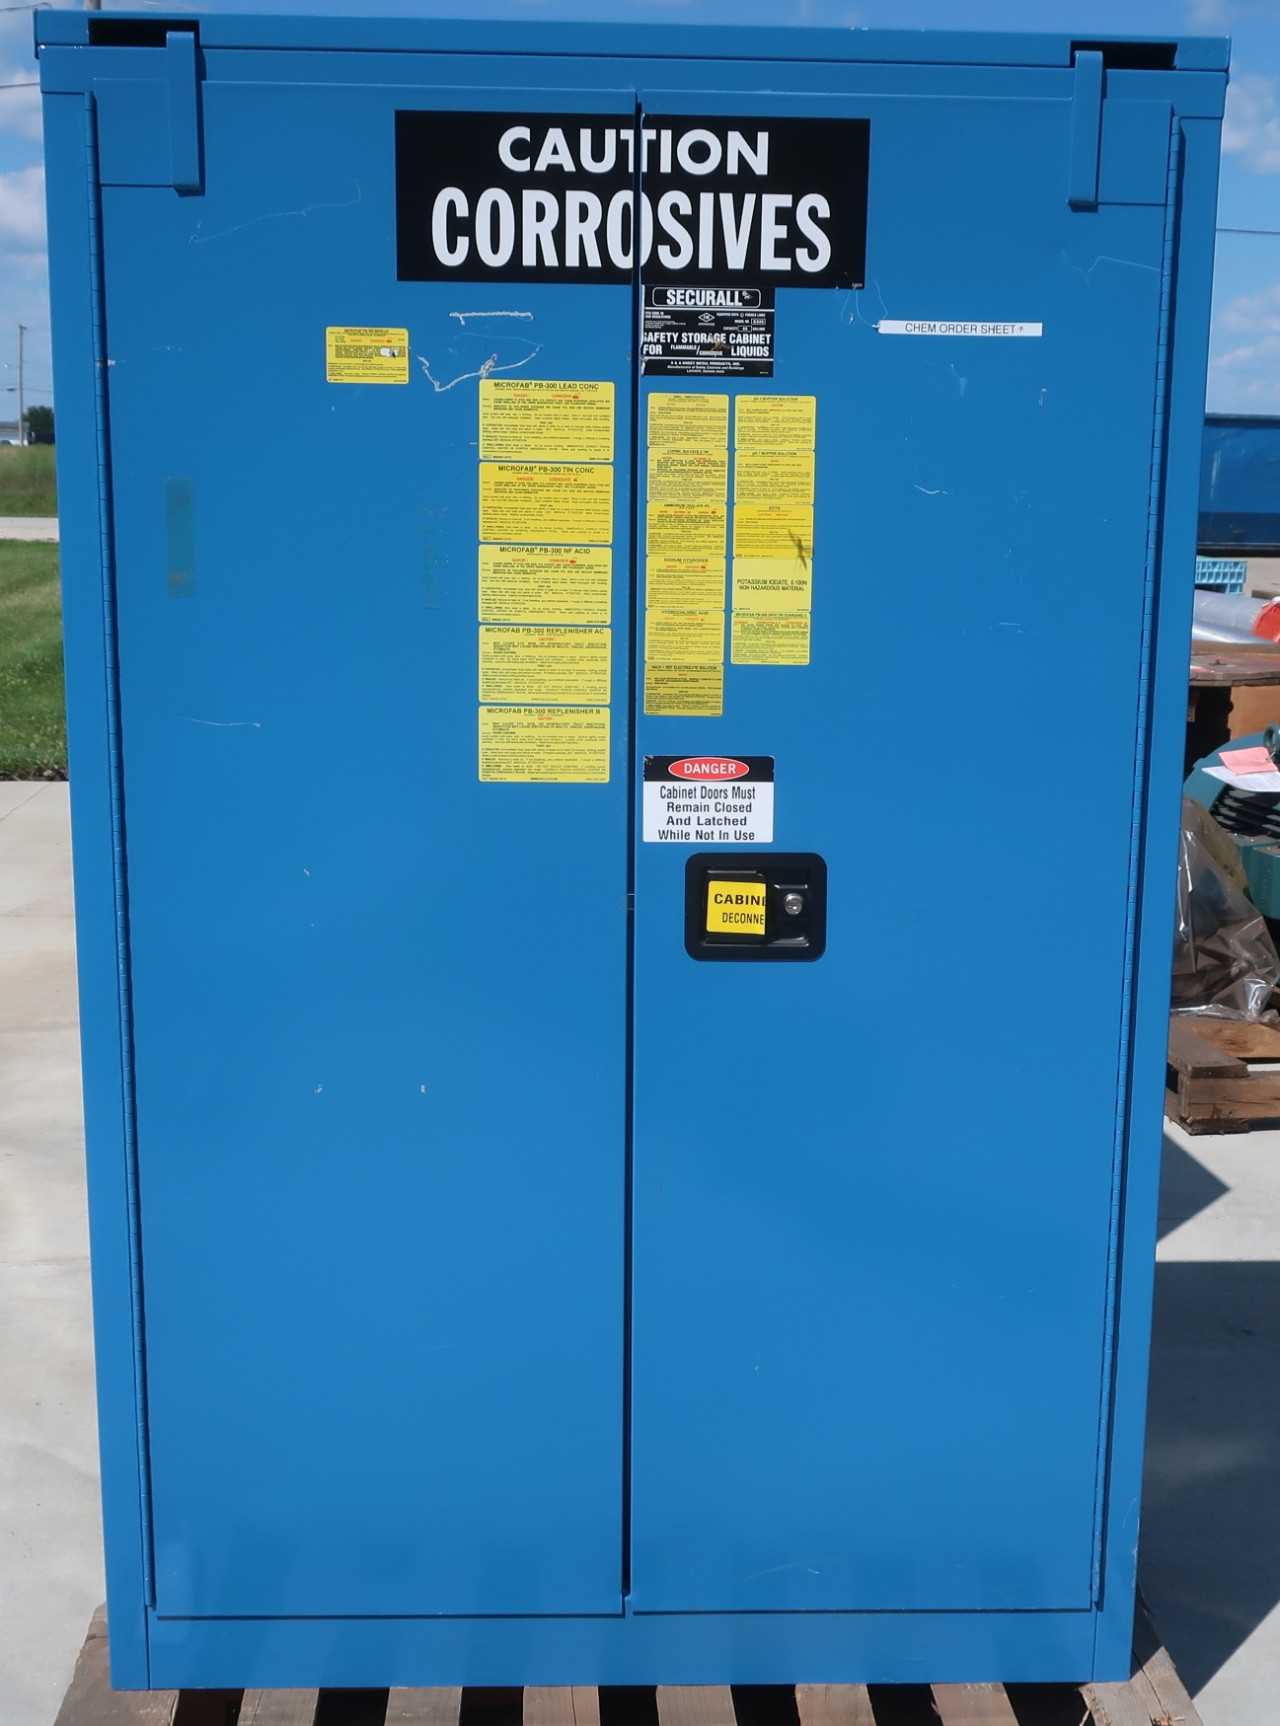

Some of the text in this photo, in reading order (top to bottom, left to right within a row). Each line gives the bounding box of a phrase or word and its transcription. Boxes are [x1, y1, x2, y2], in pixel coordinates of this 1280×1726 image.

[498, 126, 769, 176] CAUTION
[432, 186, 832, 273] CORROSIVES
[666, 289, 743, 306] SECURALL
[905, 322, 1016, 335] CHEM ORDER SHEET
[682, 333, 727, 344] STORAGE
[729, 334, 772, 345] CABINET
[643, 344, 662, 355] FOR
[731, 346, 769, 357] LIQUIDS
[683, 762, 736, 775] DANGER
[659, 785, 756, 800] Cabinet Doors Must
[666, 801, 752, 813] Remain Closed
[666, 816, 747, 826] And Latched
[658, 829, 755, 841] While Not In Use
[722, 912, 765, 925] DECONNE
